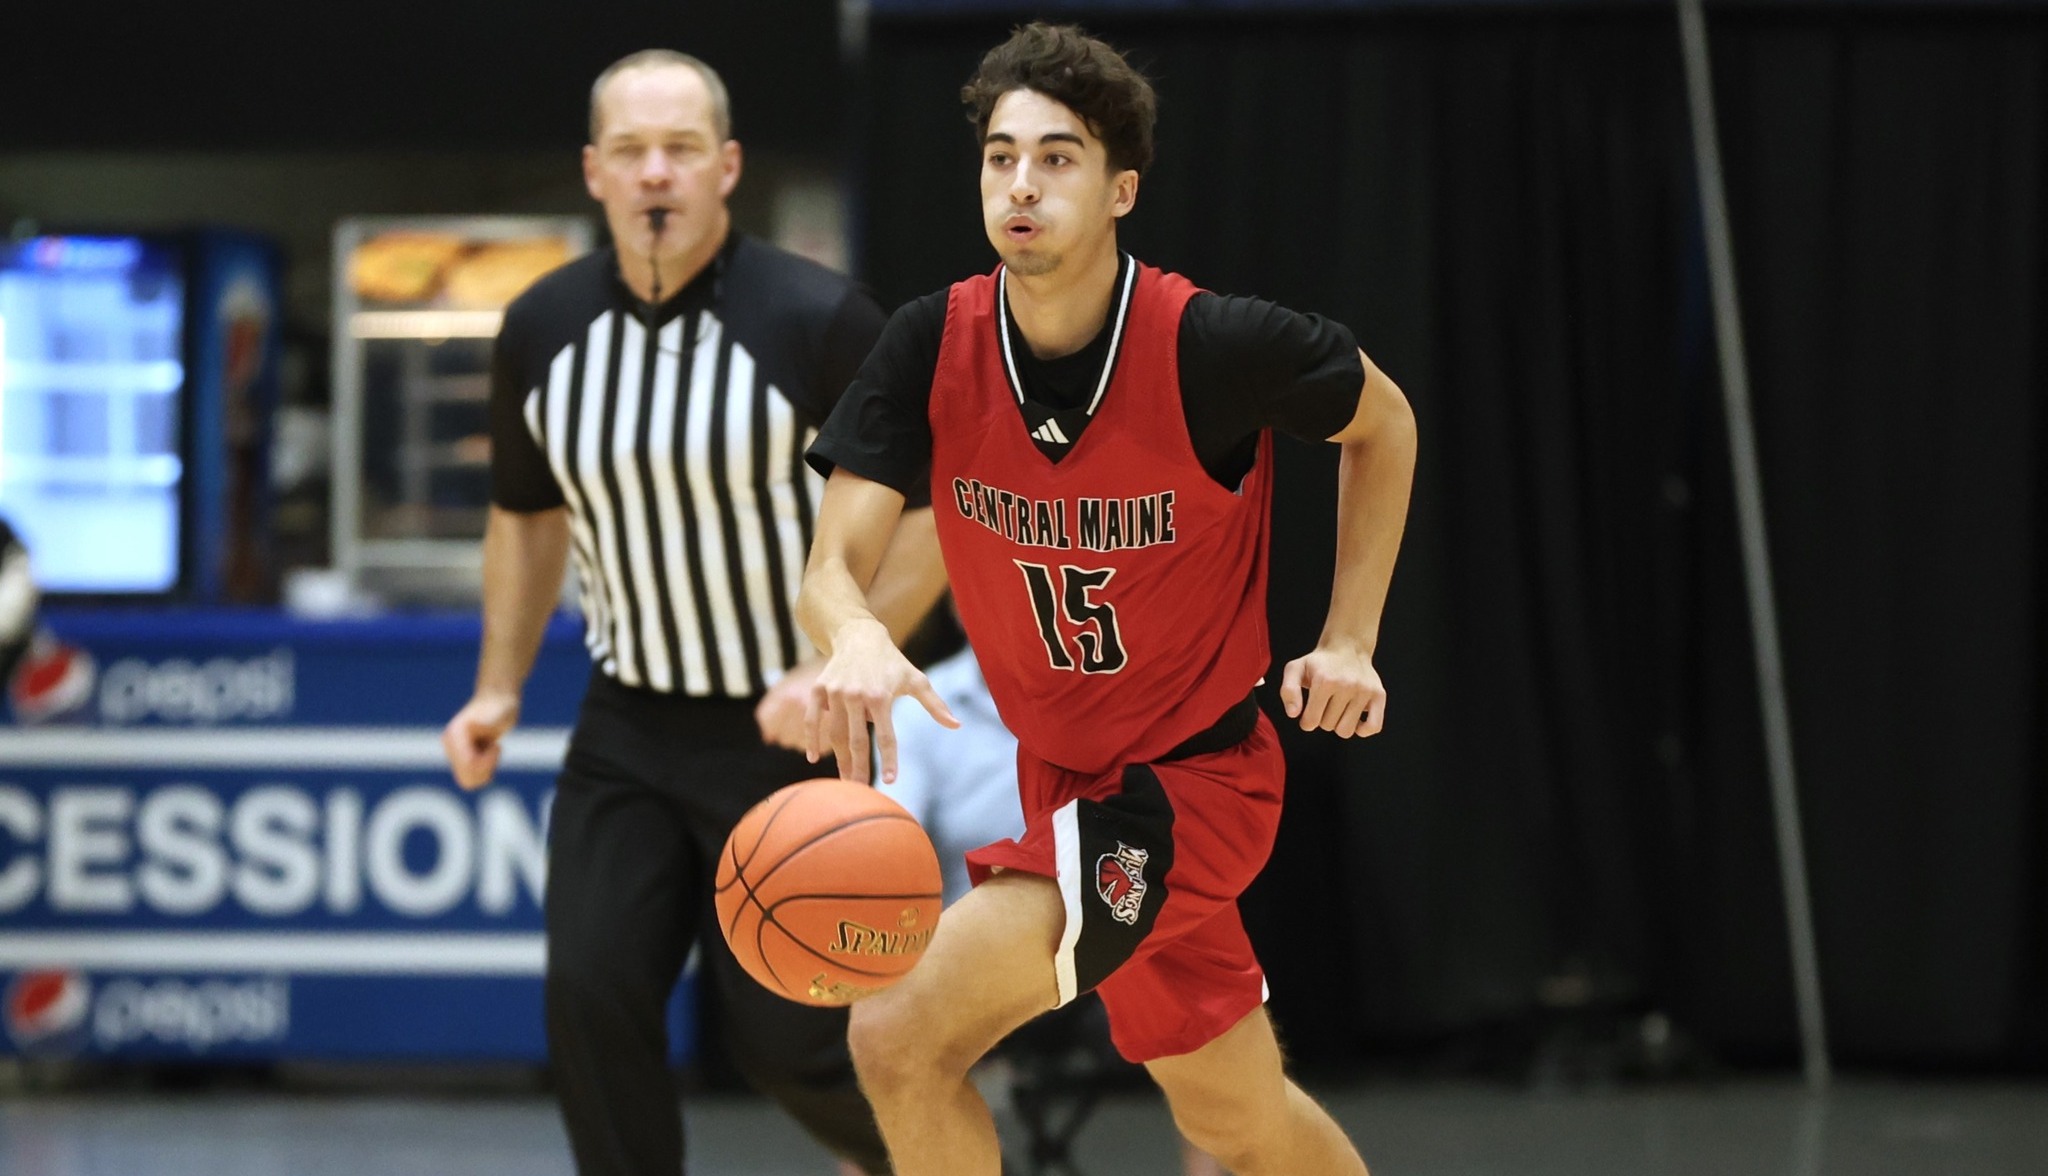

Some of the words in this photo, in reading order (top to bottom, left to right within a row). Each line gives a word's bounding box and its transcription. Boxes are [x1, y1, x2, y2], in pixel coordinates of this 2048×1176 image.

[953, 476, 1072, 550] CENTRAL
[1077, 490, 1176, 552] MAINE
[1012, 558, 1128, 675] 15
[102, 650, 294, 721] pepsi
[94, 977, 289, 1051] pepsi
